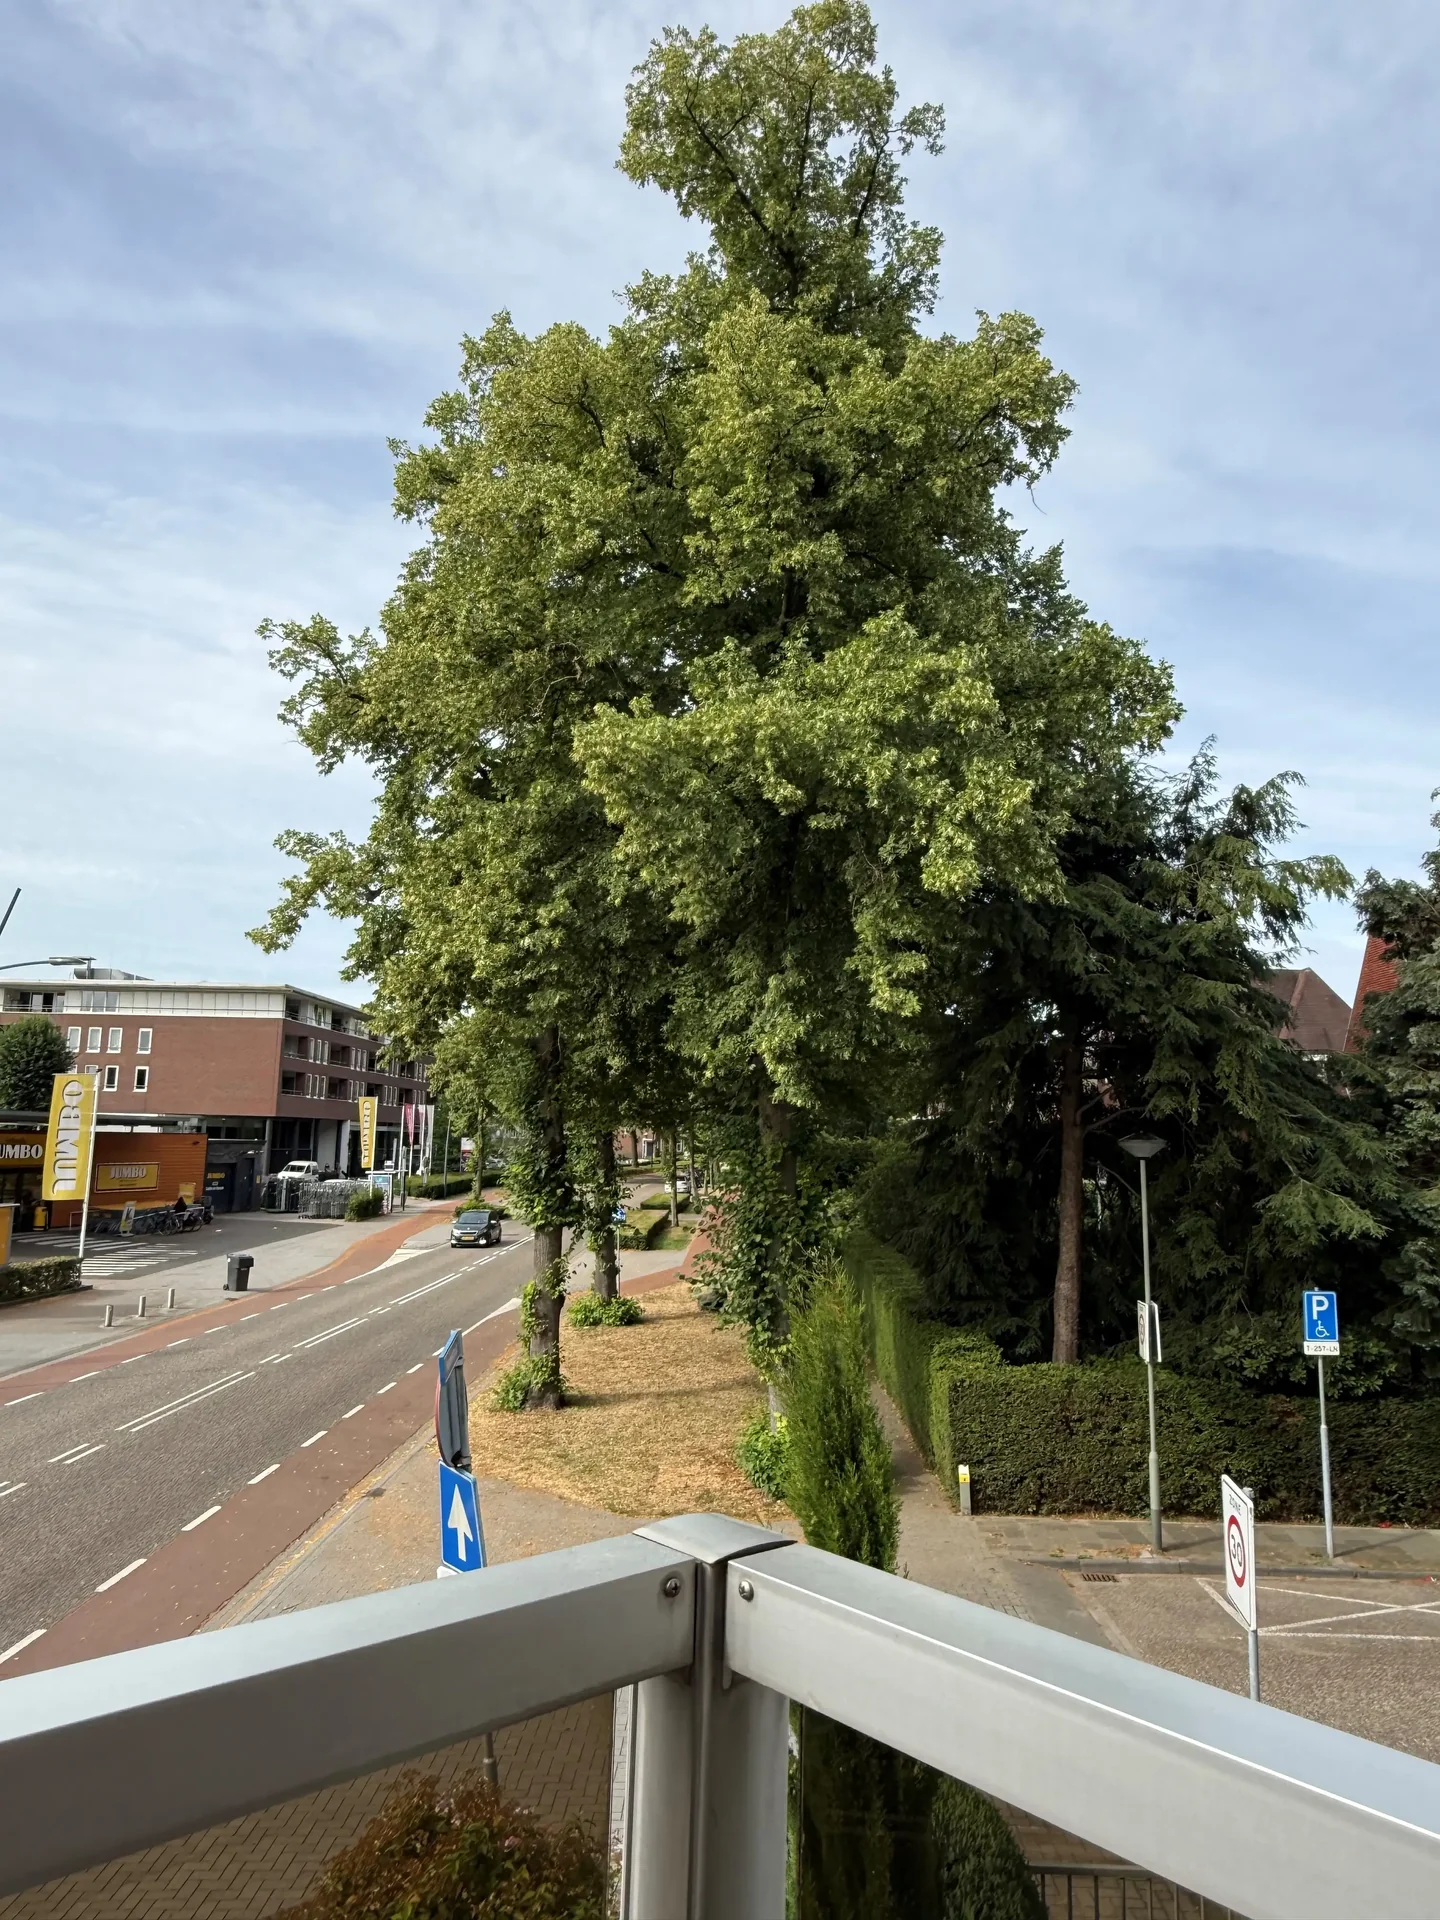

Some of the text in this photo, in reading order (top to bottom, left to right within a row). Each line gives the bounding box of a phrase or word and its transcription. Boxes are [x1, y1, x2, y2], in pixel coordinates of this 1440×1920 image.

[0, 1144, 43, 1159] UMBO
[110, 1166, 147, 1179] JUMBO
[1312, 1295, 1329, 1320] P
[1231, 1534, 1243, 1567] 30
